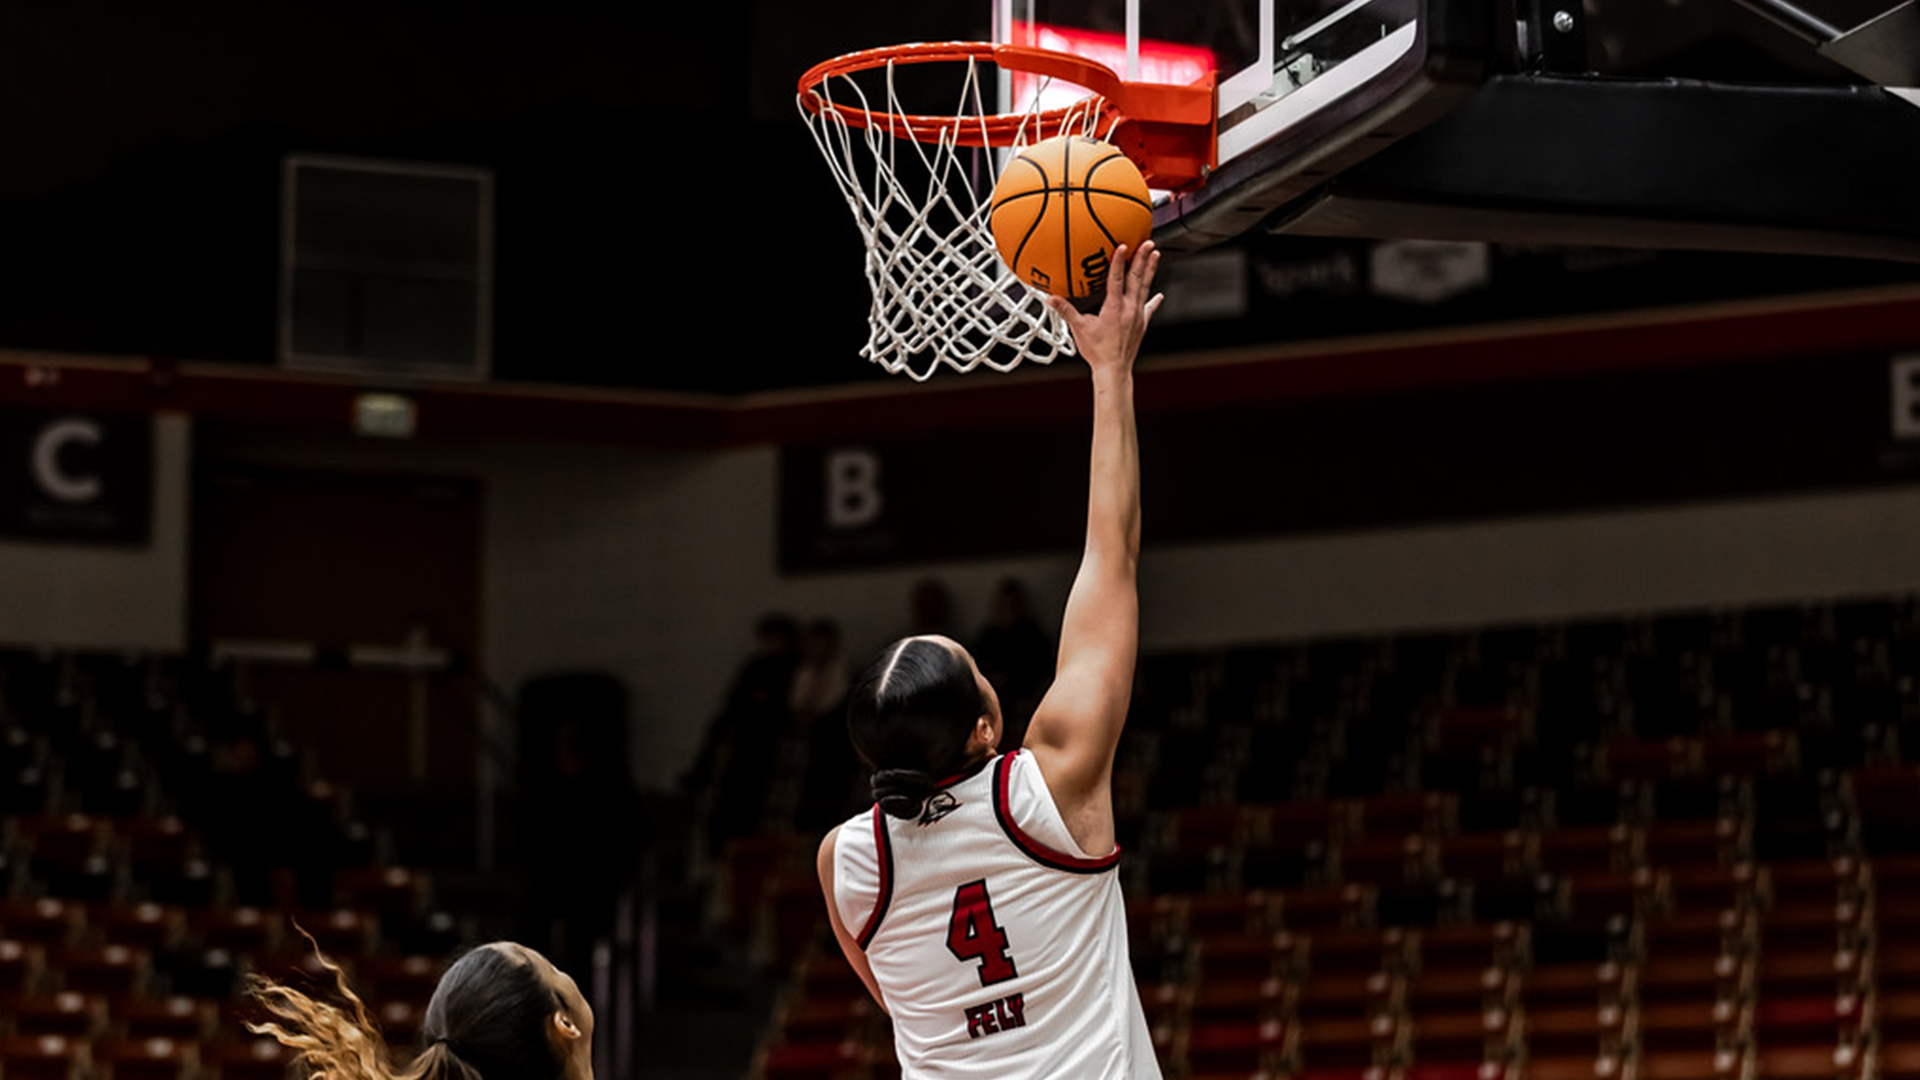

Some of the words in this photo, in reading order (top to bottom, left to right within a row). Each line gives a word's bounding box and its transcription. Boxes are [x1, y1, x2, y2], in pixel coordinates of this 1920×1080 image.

[33, 419, 103, 501] C
[827, 448, 884, 527] B
[946, 878, 1019, 988] 4
[964, 993, 1026, 1040] FELY
